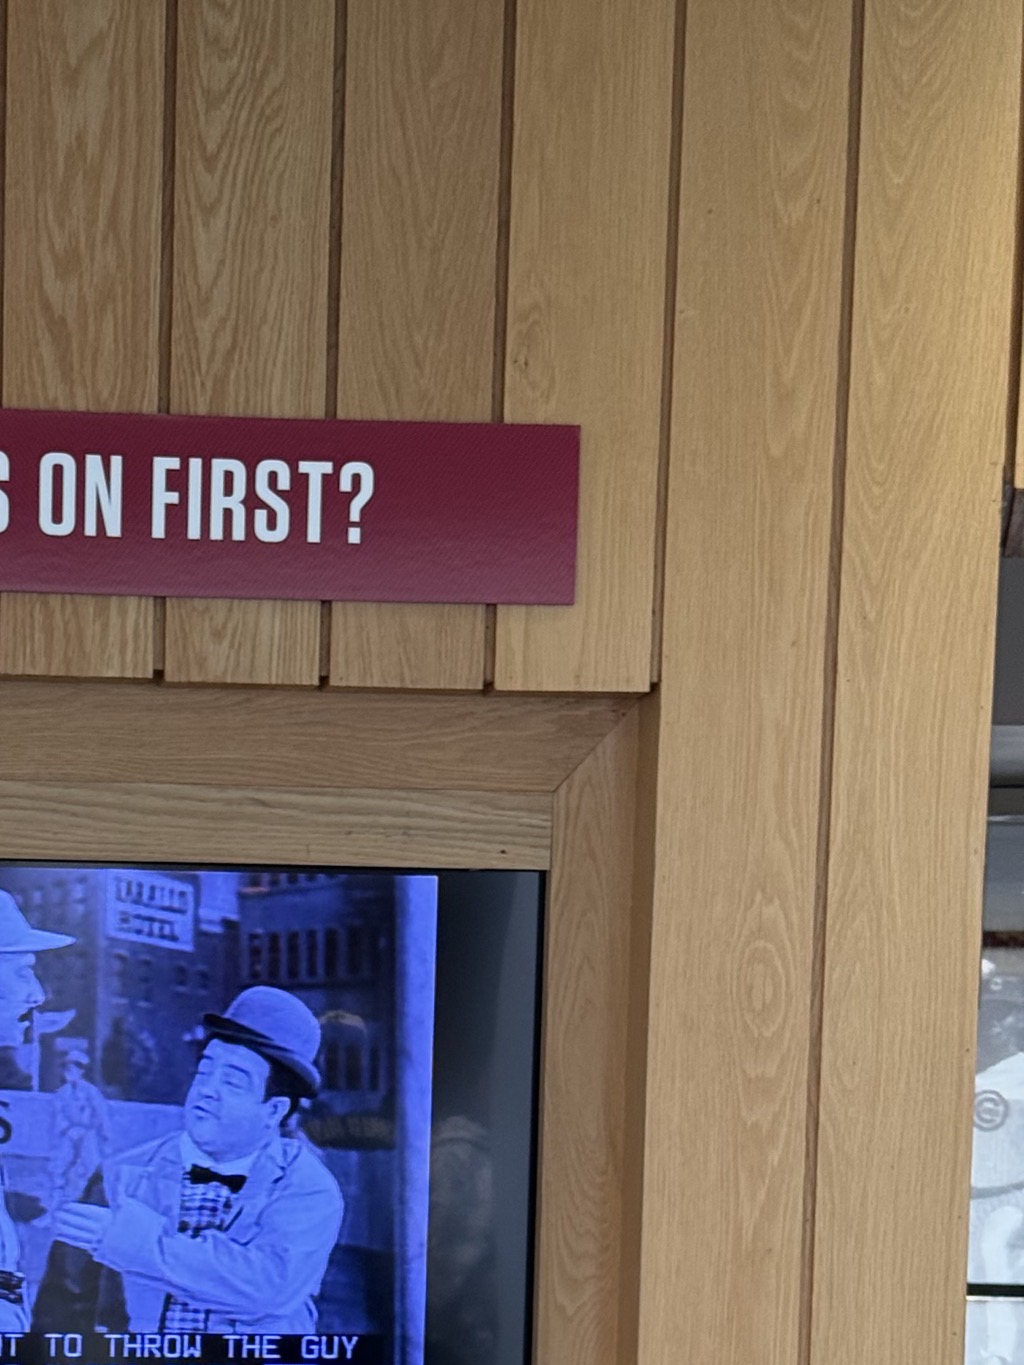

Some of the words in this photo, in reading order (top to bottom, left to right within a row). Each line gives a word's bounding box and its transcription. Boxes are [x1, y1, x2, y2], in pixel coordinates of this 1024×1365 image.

[38, 452, 123, 538] ON
[151, 455, 375, 545] FIRST?
[44, 1334, 83, 1358] TO
[104, 1334, 202, 1360] THROW
[223, 1335, 282, 1360] THE
[301, 1336, 360, 1360] GUY
